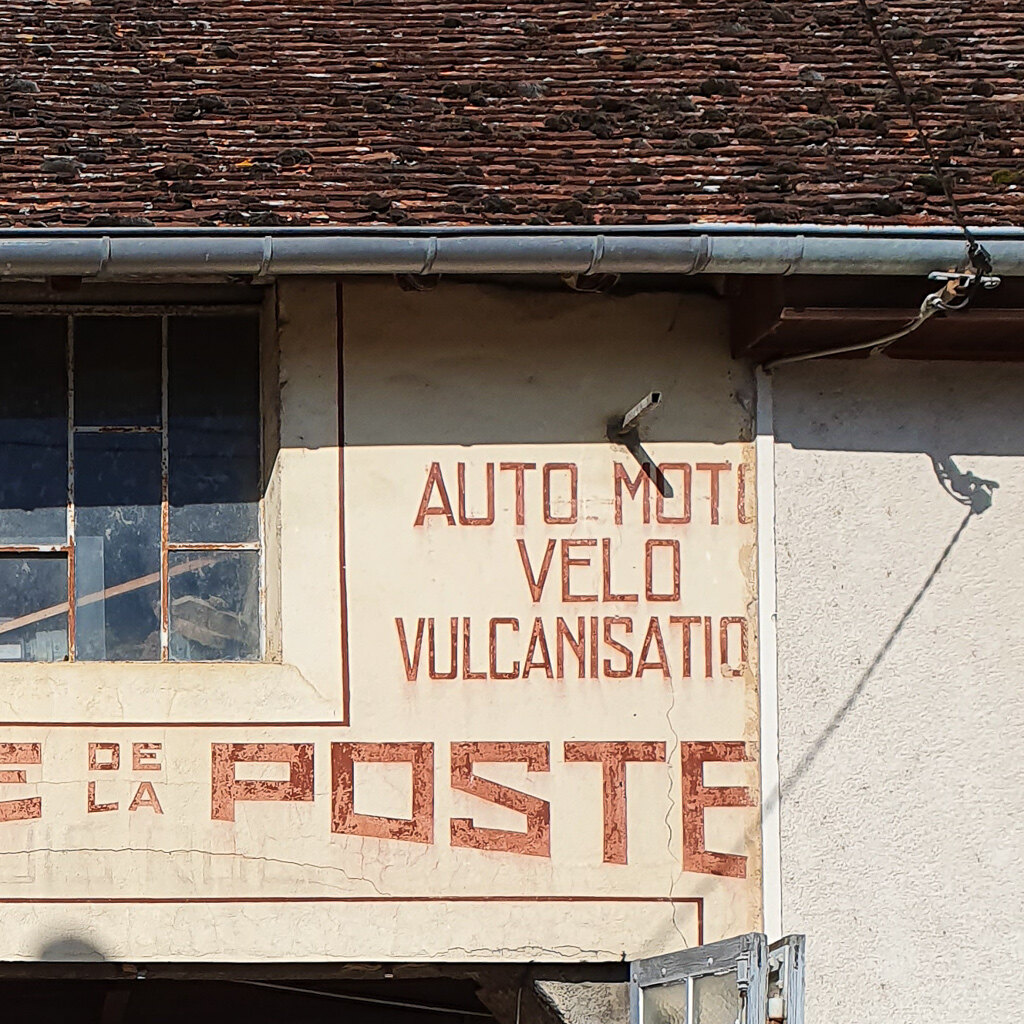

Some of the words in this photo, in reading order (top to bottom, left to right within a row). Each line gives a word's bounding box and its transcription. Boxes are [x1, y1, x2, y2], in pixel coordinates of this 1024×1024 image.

[414, 462, 577, 526] AUTO
[516, 538, 681, 602] VELO
[88, 742, 163, 771] DE
[88, 781, 164, 814] LA
[211, 741, 757, 879] POSTE
